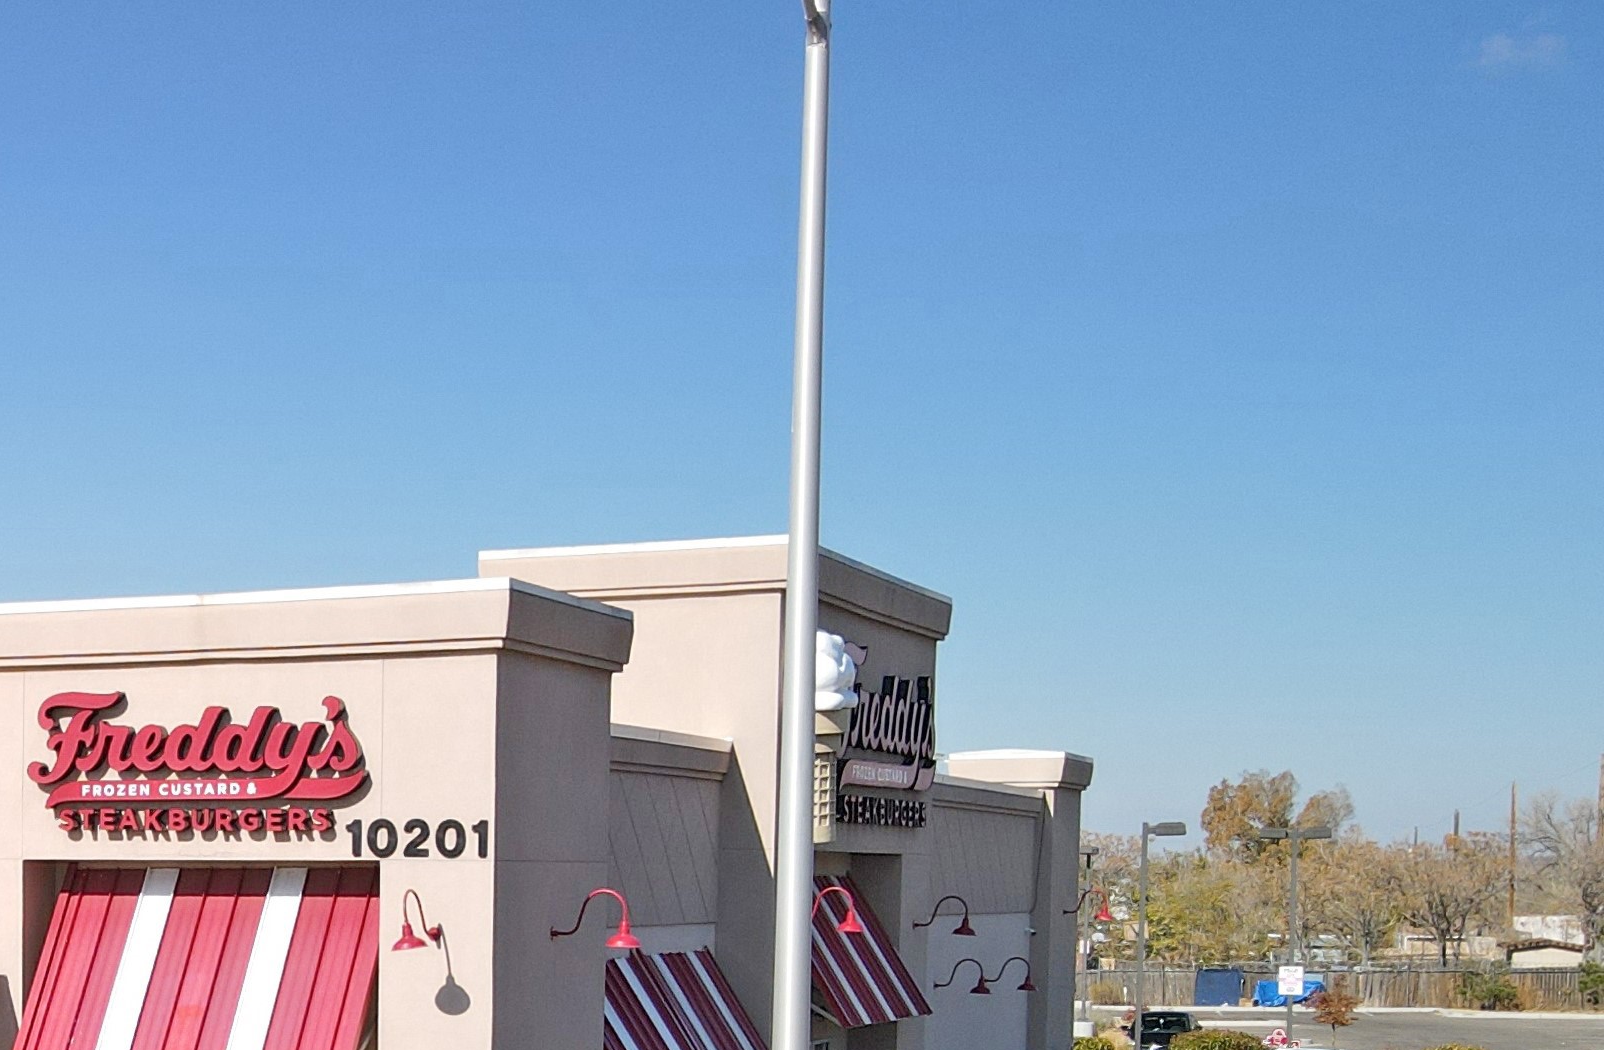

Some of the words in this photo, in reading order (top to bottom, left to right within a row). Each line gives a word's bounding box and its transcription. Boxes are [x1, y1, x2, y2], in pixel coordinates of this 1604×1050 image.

[27, 691, 368, 803] Freddy's
[81, 784, 151, 797] FROZEN
[158, 782, 241, 796] CUSTARD
[246, 782, 257, 795] &
[58, 807, 333, 832] STEAKBURGERS
[345, 818, 489, 858] 10201
